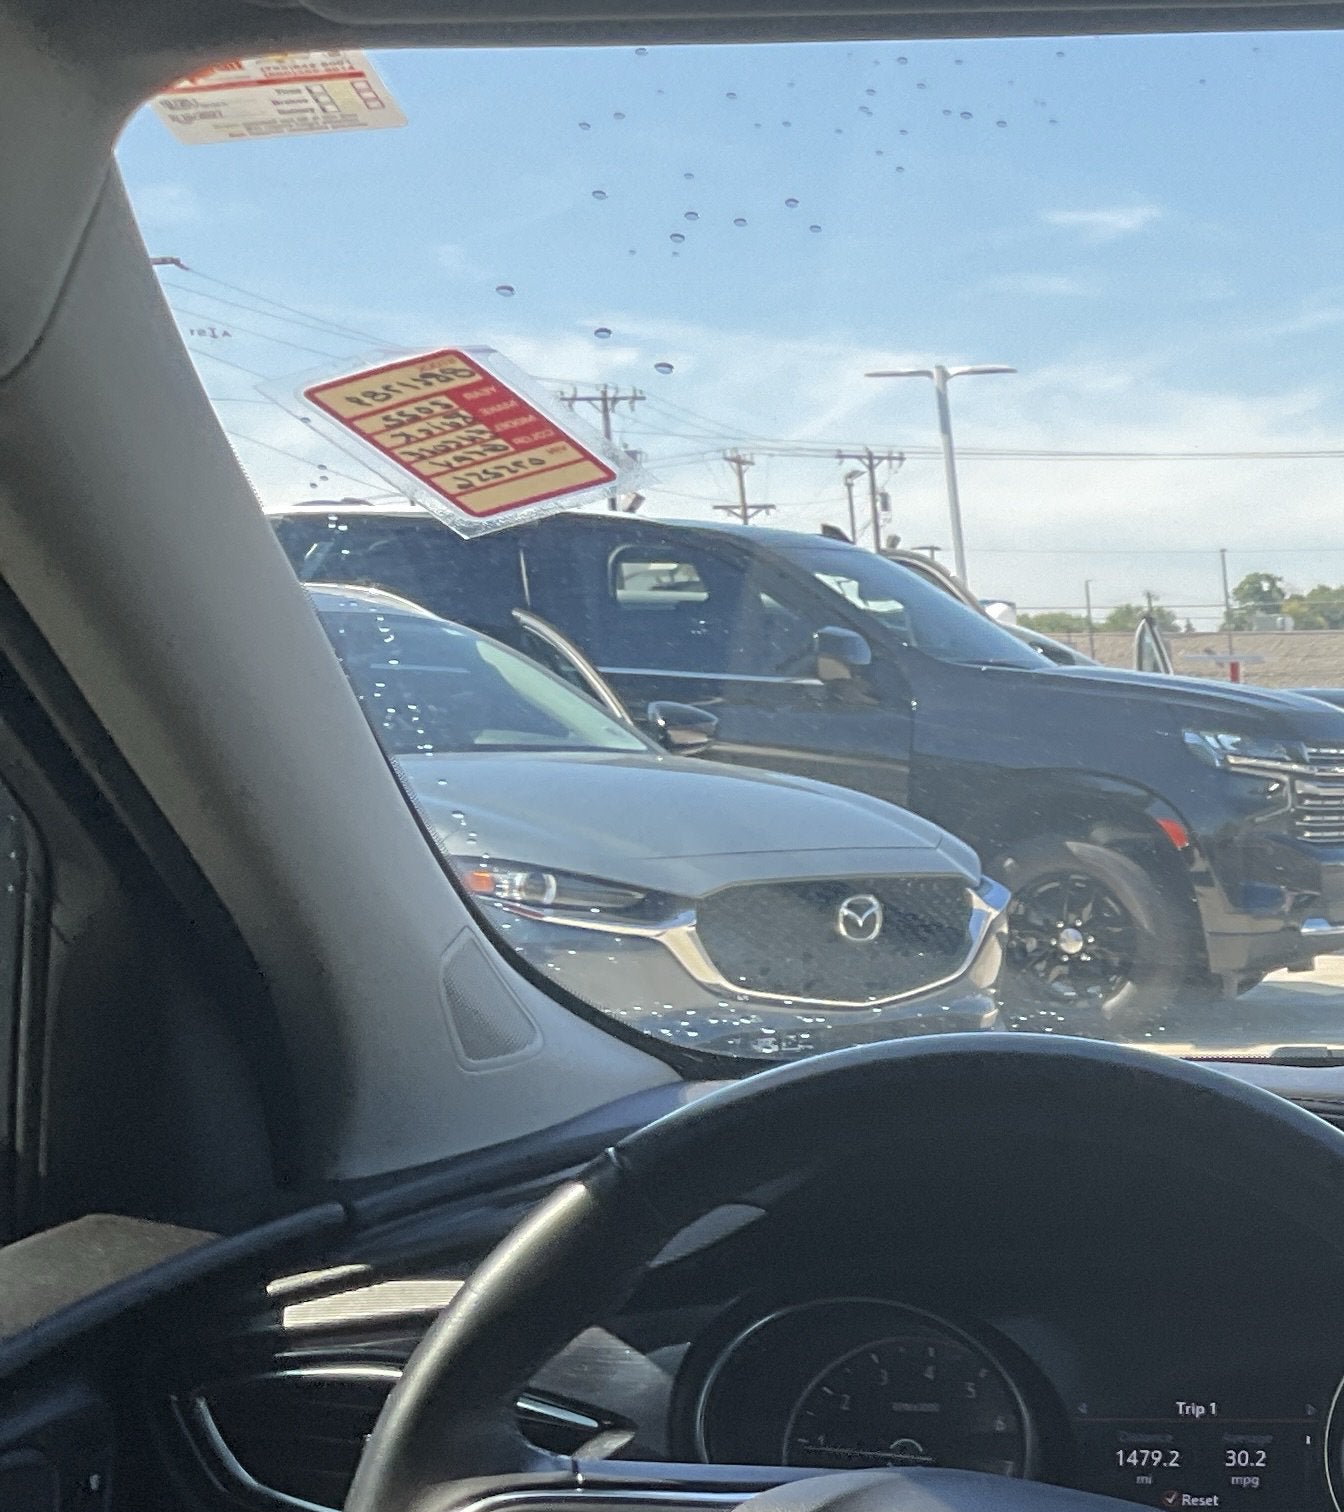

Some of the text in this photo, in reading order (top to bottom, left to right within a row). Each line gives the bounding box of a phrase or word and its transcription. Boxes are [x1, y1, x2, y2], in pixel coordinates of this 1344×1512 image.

[1176, 1401, 1218, 1418] Trip 1
[1116, 1449, 1181, 1467] 1479.2
[1225, 1449, 1267, 1467] 30.2
[1136, 1475, 1152, 1485] mi
[1231, 1476, 1260, 1488] mpg
[1182, 1494, 1219, 1506] Reset
